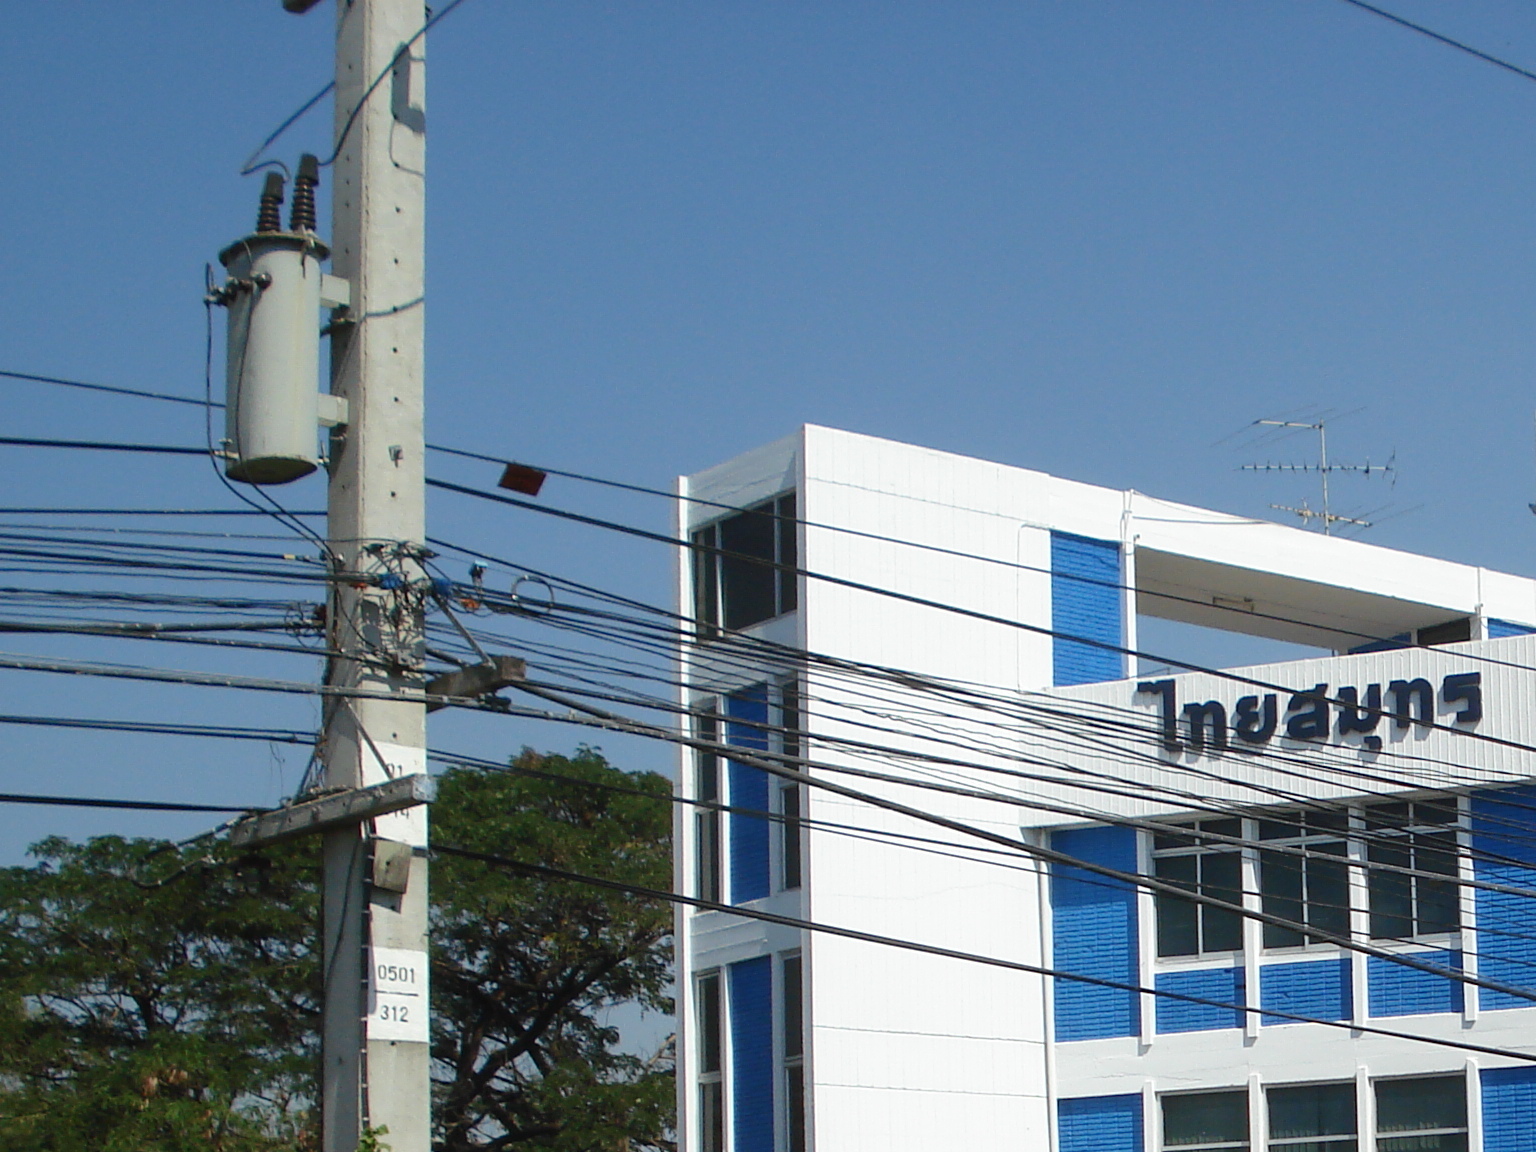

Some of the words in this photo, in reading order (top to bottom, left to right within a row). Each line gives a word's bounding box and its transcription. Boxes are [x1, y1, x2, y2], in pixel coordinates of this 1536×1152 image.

[1137, 671, 1483, 753] ไทยสมุทร
[377, 964, 416, 984] 0501
[380, 1004, 409, 1023] 312
